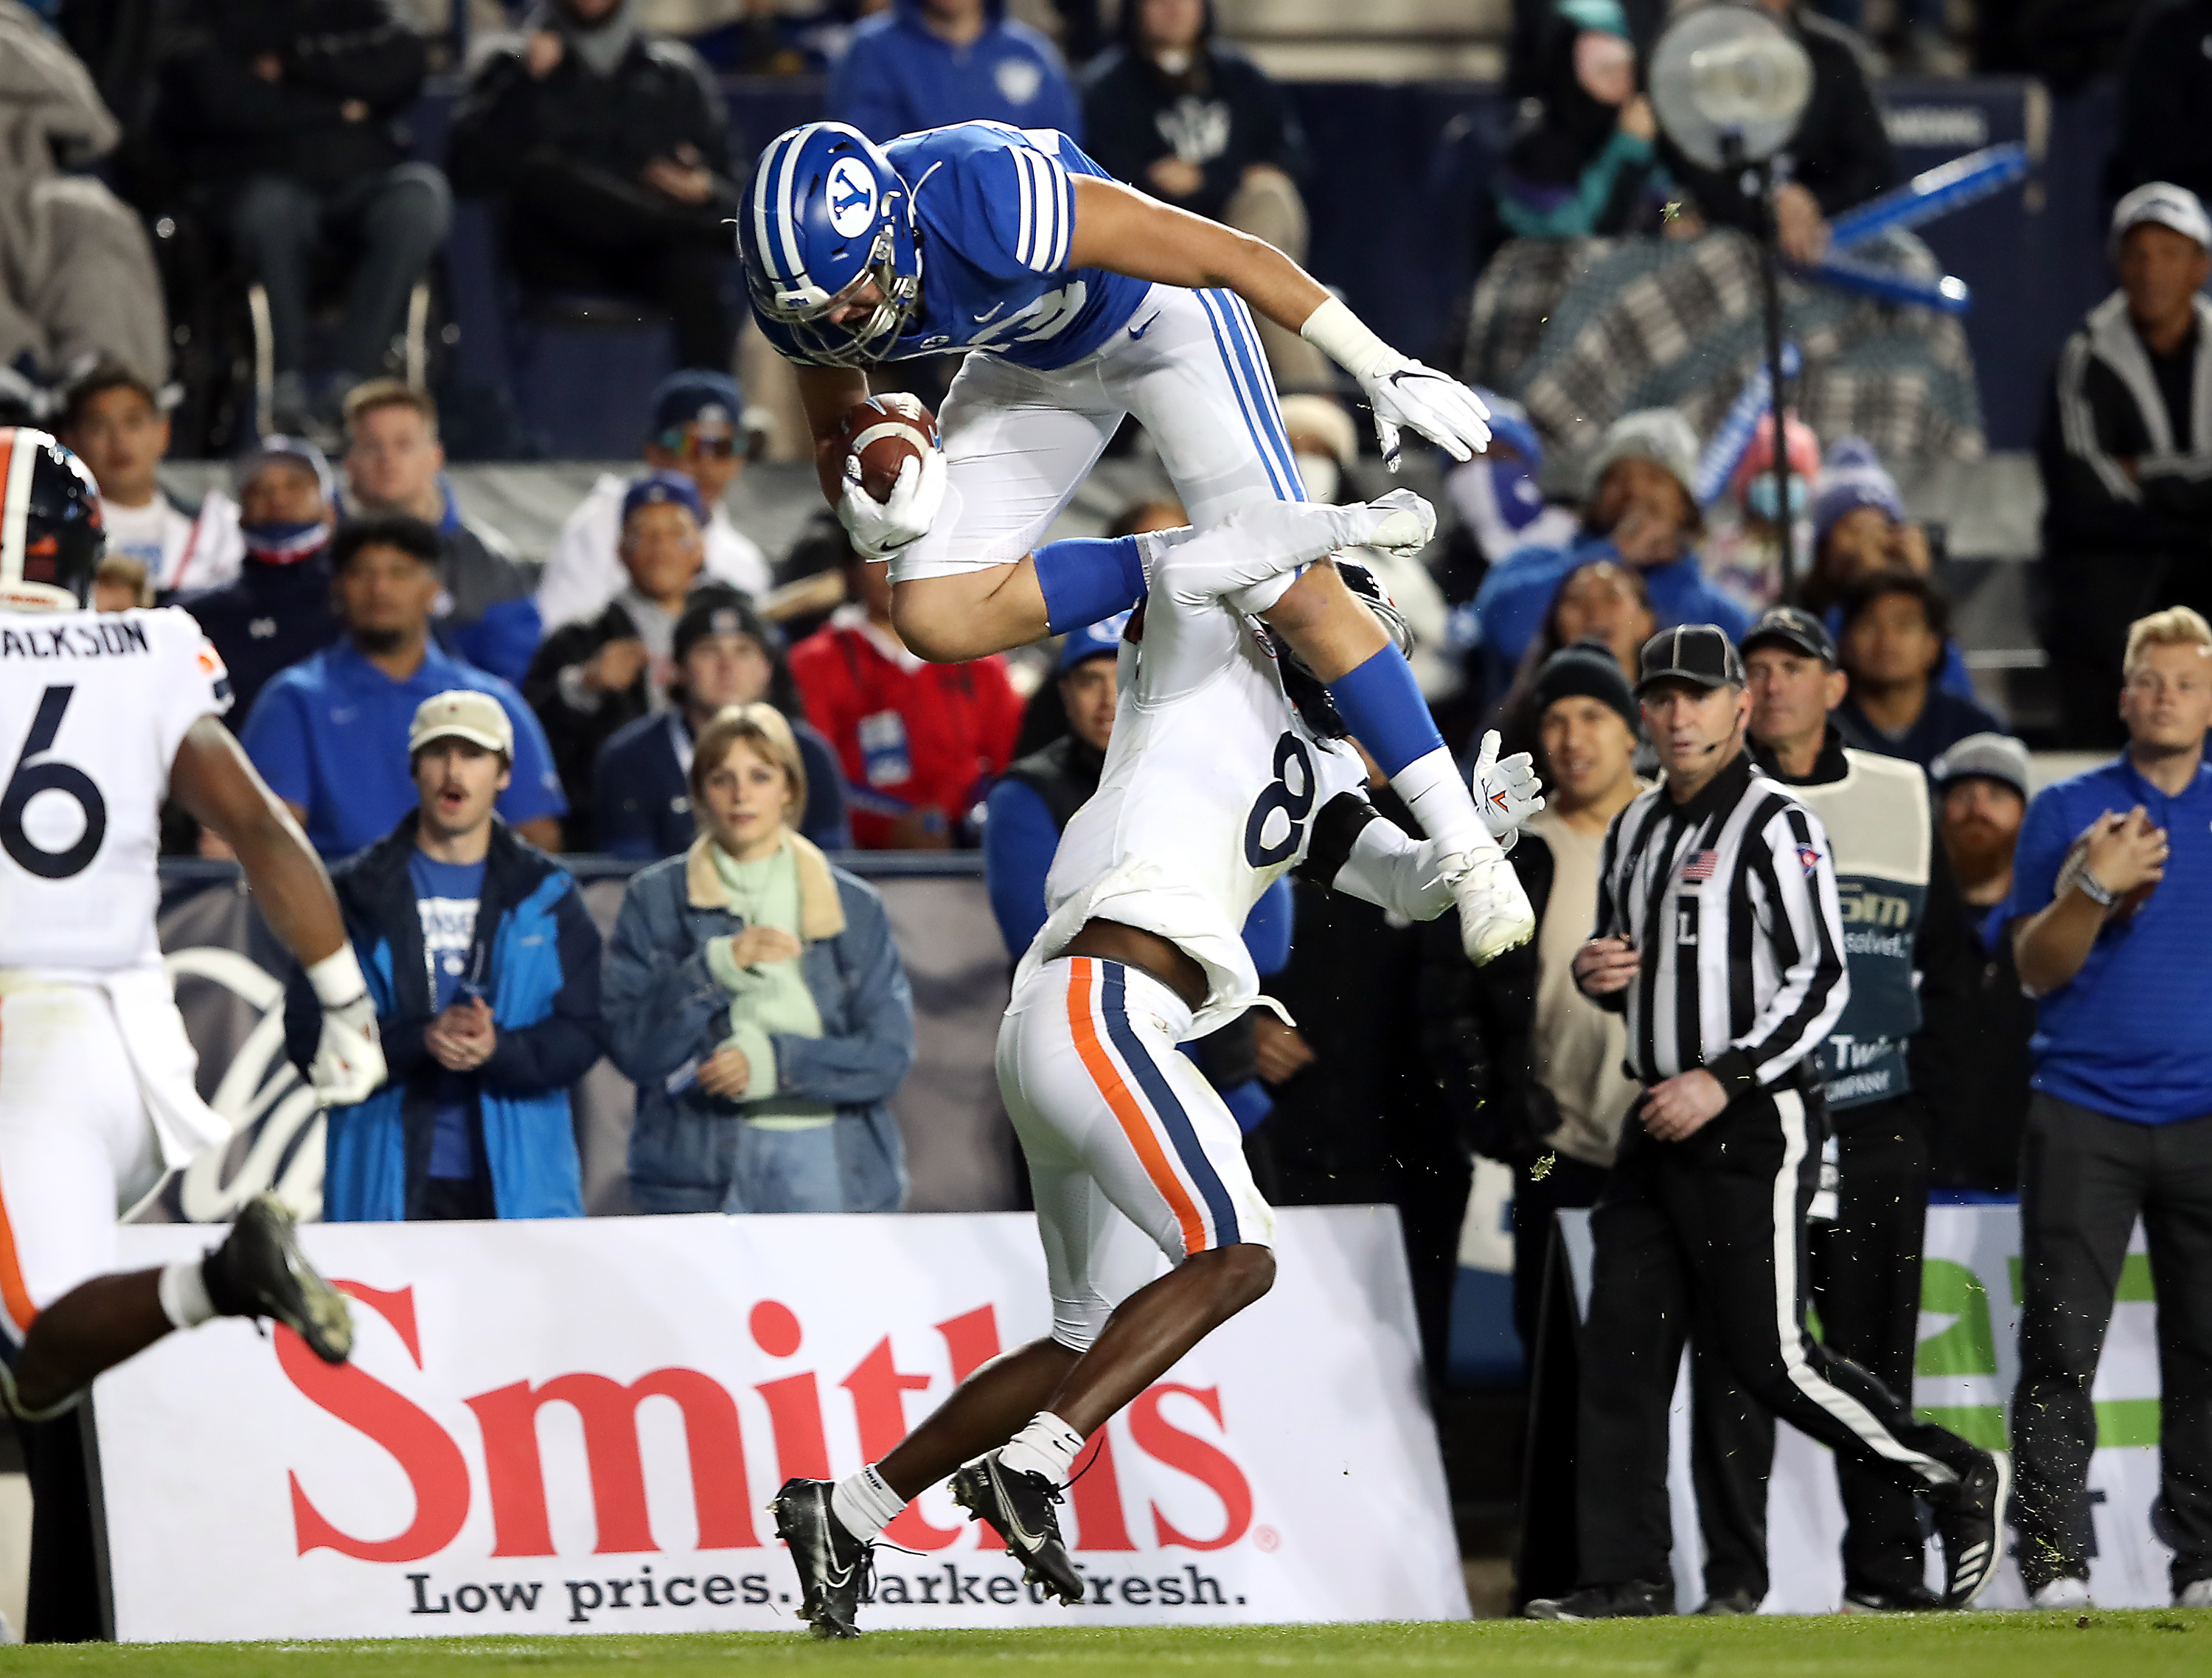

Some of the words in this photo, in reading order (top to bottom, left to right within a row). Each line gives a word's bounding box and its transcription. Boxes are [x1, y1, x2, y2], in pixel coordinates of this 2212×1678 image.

[832, 167, 872, 220] Y
[0, 684, 107, 879] 6
[1244, 730, 1316, 868] 8
[1676, 911, 1698, 946] L
[405, 1572, 543, 1615] Low
[564, 1564, 790, 1623] prices.
[857, 1563, 1044, 1605] arket
[1068, 1564, 1248, 1605] resh.
